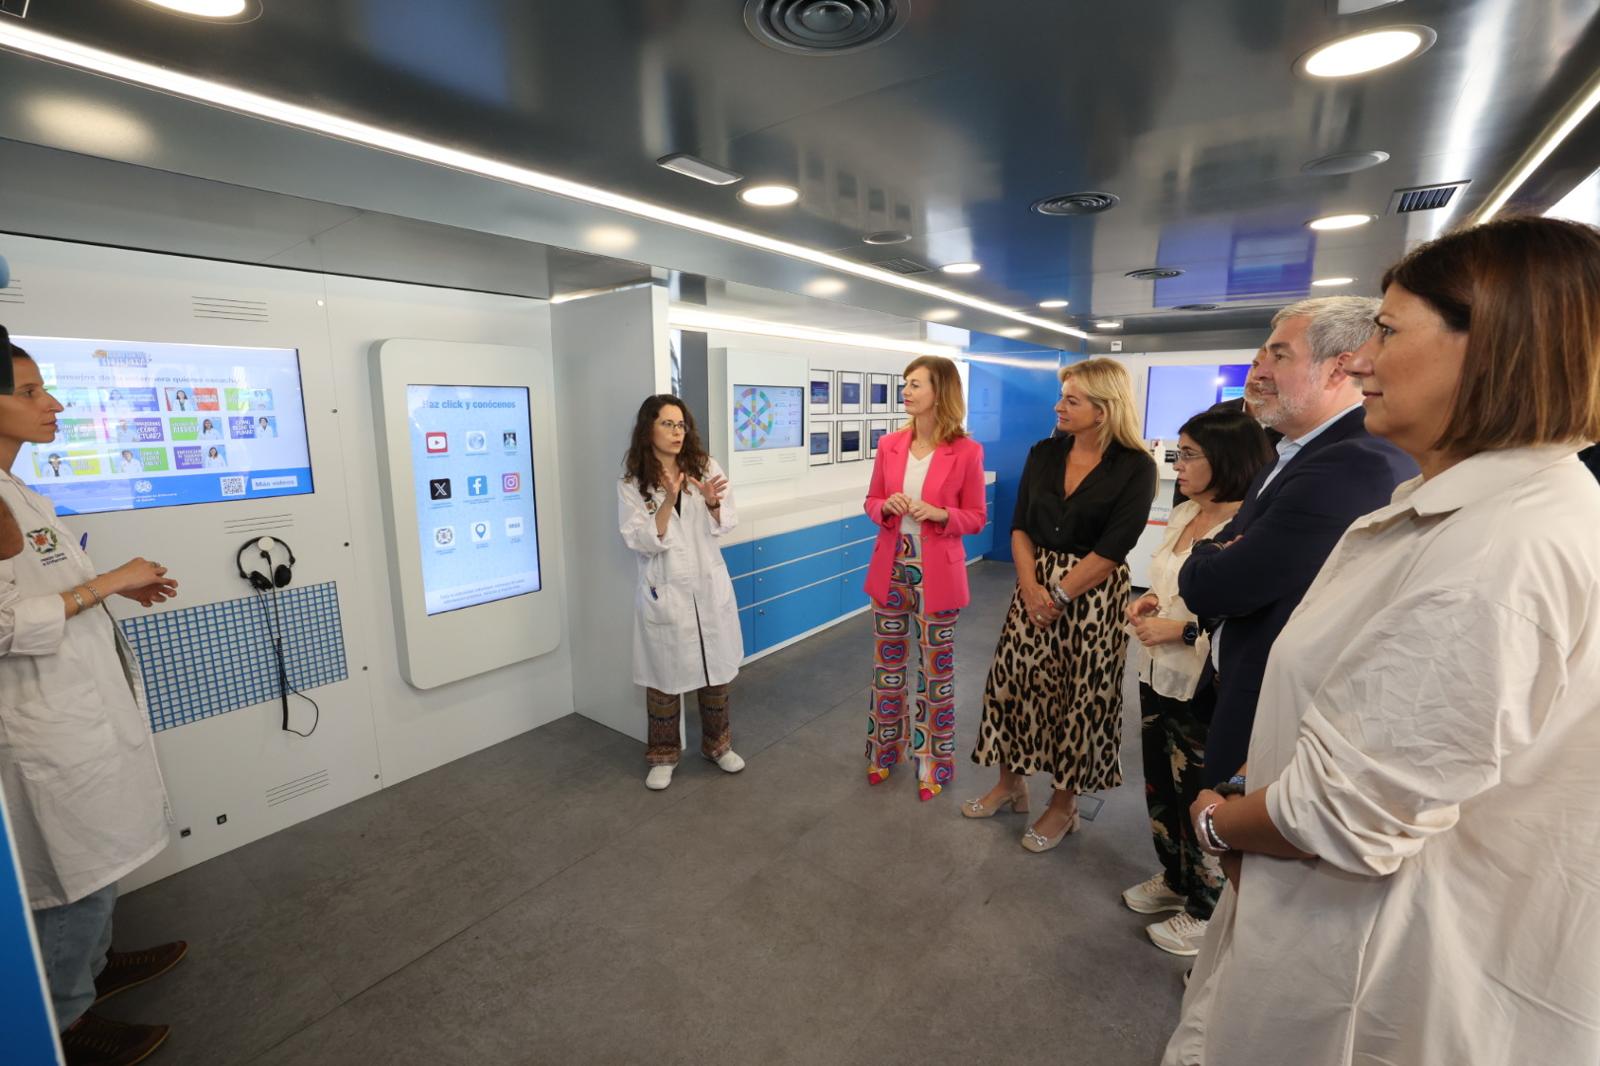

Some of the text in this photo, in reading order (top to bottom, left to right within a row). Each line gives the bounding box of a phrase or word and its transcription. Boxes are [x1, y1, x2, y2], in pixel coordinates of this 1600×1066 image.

[442, 400, 464, 408] click
[466, 401, 471, 411] y
[472, 400, 516, 409] conócenos
